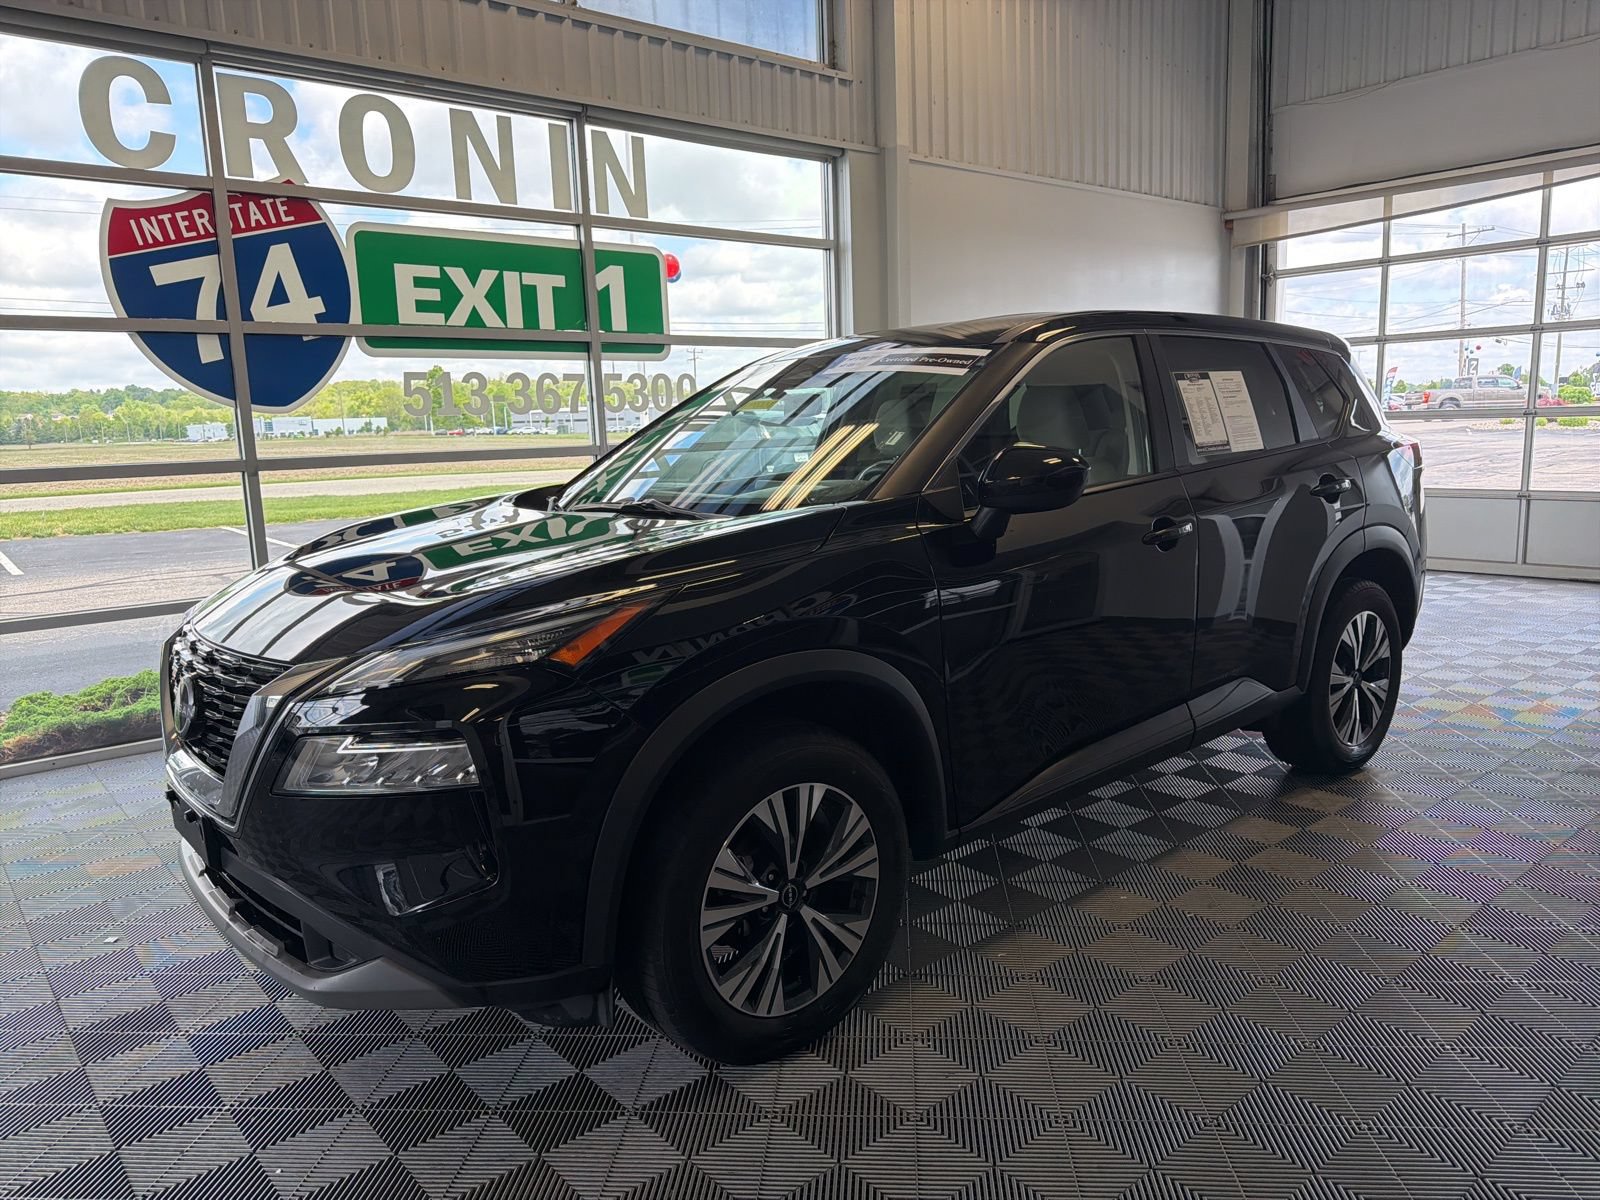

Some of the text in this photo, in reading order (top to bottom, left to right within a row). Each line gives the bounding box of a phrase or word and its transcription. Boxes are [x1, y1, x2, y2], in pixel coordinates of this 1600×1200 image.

[78, 56, 649, 219] CRONIN
[129, 198, 295, 246] INTERTATE
[149, 243, 326, 364] 74
[393, 263, 628, 332] EXIT 1
[919, 355, 973, 366] Pre-Owned
